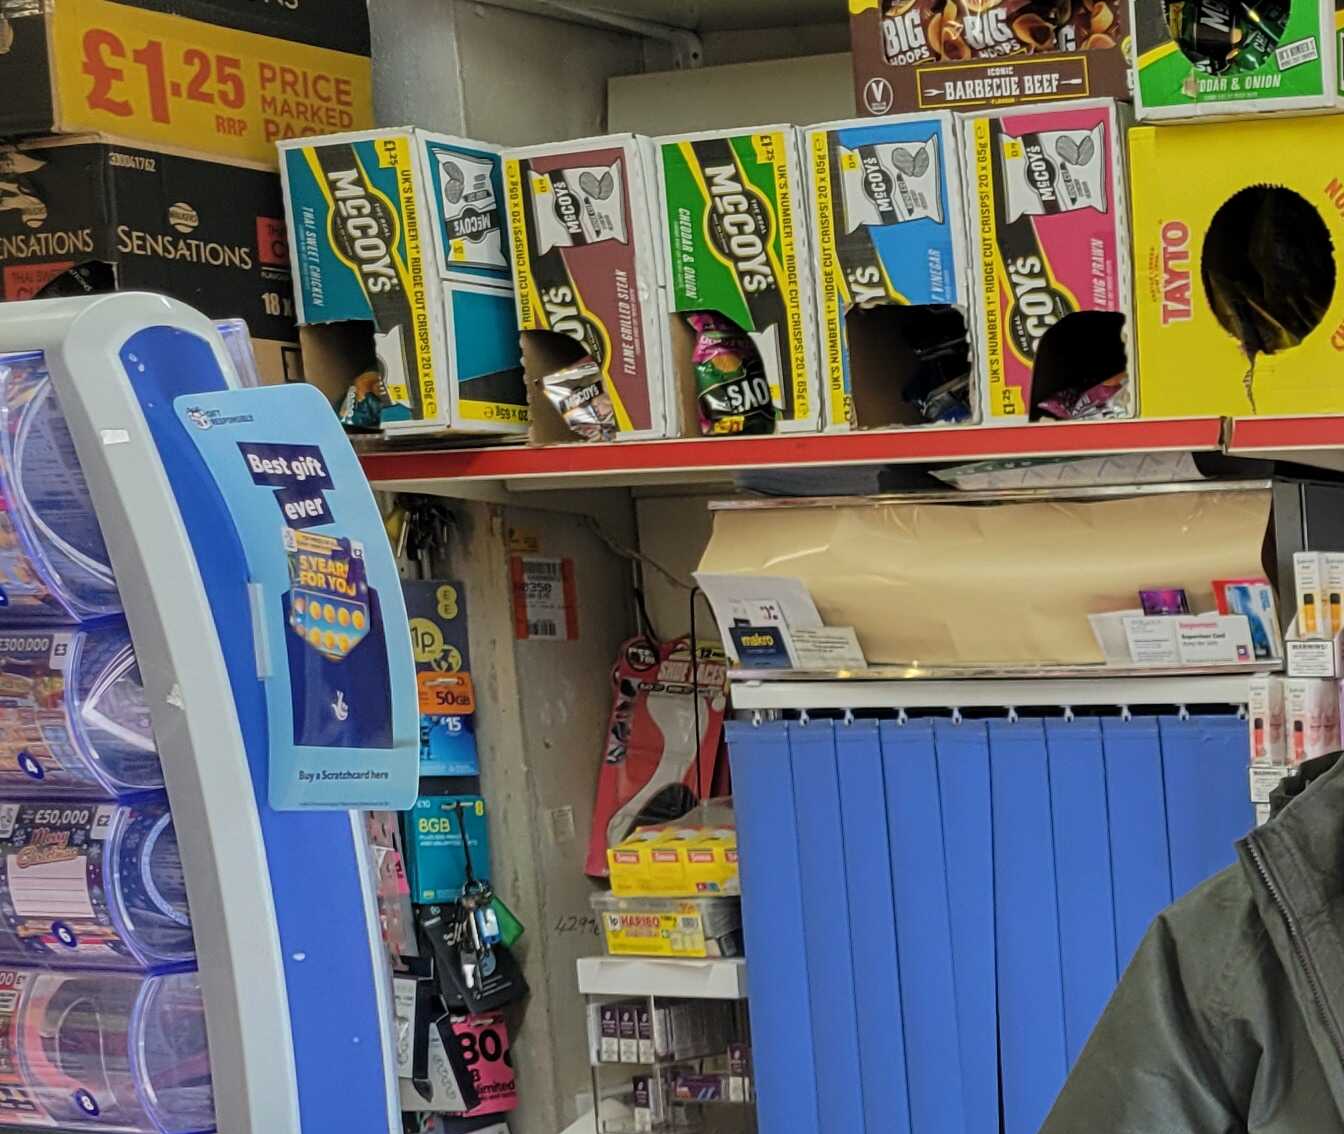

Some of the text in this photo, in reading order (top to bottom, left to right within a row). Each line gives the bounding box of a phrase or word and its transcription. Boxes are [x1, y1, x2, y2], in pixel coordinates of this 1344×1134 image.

[884, 8, 927, 58] BIG
[82, 27, 246, 125] £1.25
[258, 62, 353, 108] PRICE
[944, 73, 1060, 101] BARBECUE BEEF
[215, 115, 248, 137] RRP
[260, 94, 353, 129] MARKED
[117, 225, 253, 271] SENSATIONS
[1162, 220, 1193, 328] TAYTO
[247, 453, 328, 482] Best gift
[284, 496, 325, 521] ever
[434, 690, 471, 706] 50GB
[418, 817, 451, 833] 8GB
